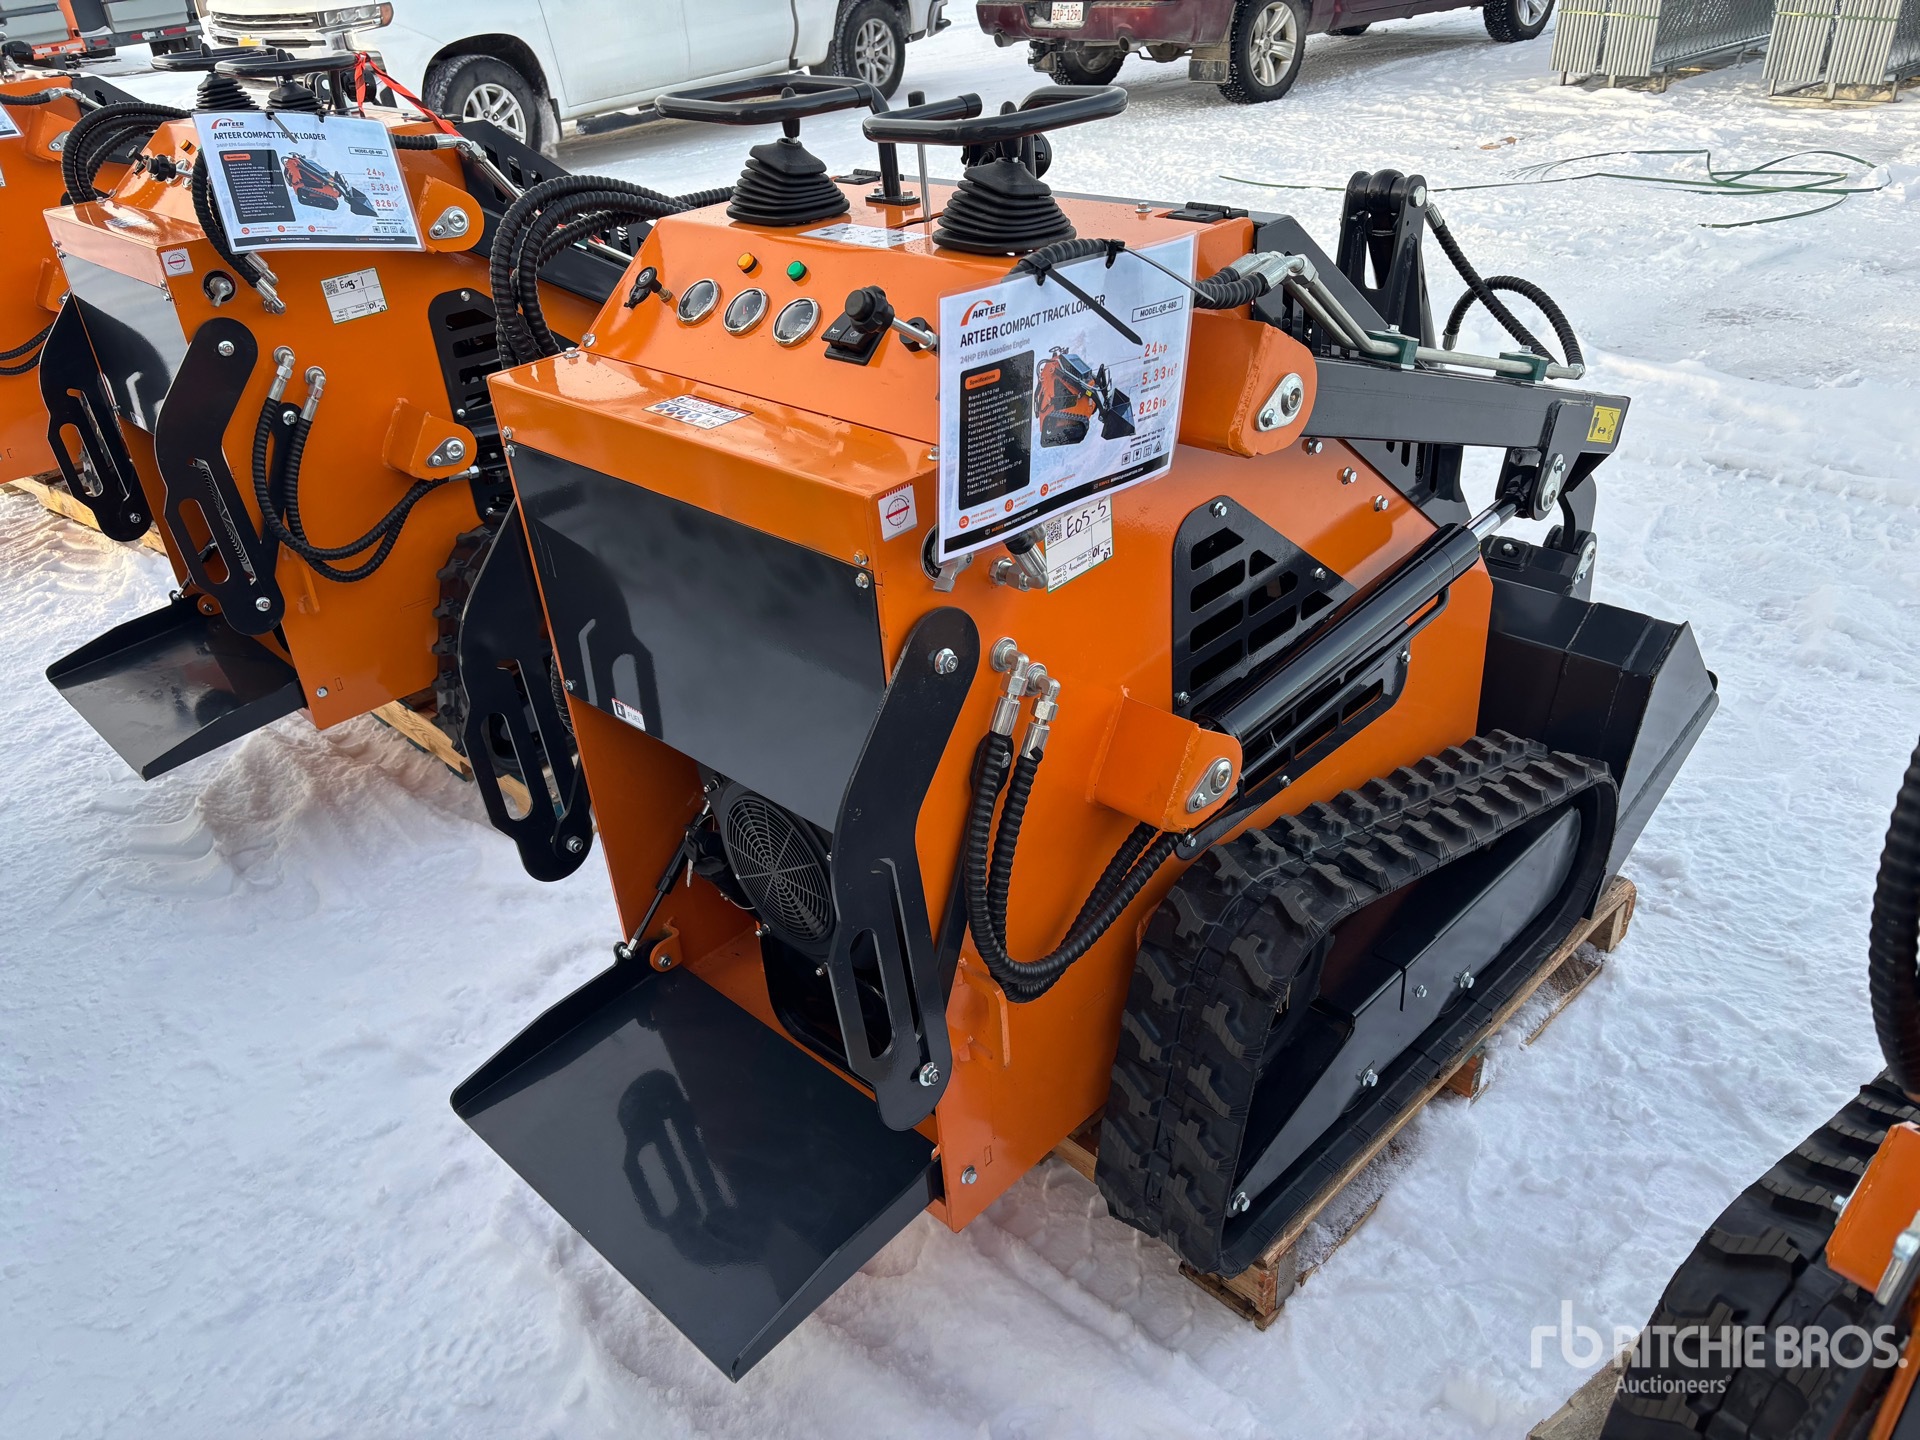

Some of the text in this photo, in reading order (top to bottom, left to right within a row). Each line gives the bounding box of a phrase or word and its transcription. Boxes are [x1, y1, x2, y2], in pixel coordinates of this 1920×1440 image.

[214, 131, 242, 140] ARTEER
[242, 131, 276, 139] COMPACT
[972, 302, 1005, 319] ARTEER
[960, 293, 1105, 348] ARTEER COMPACT TRACK LOAER
[960, 336, 1029, 364] 24HP EPA Gasoline Engine
[969, 372, 995, 385] Specifications
